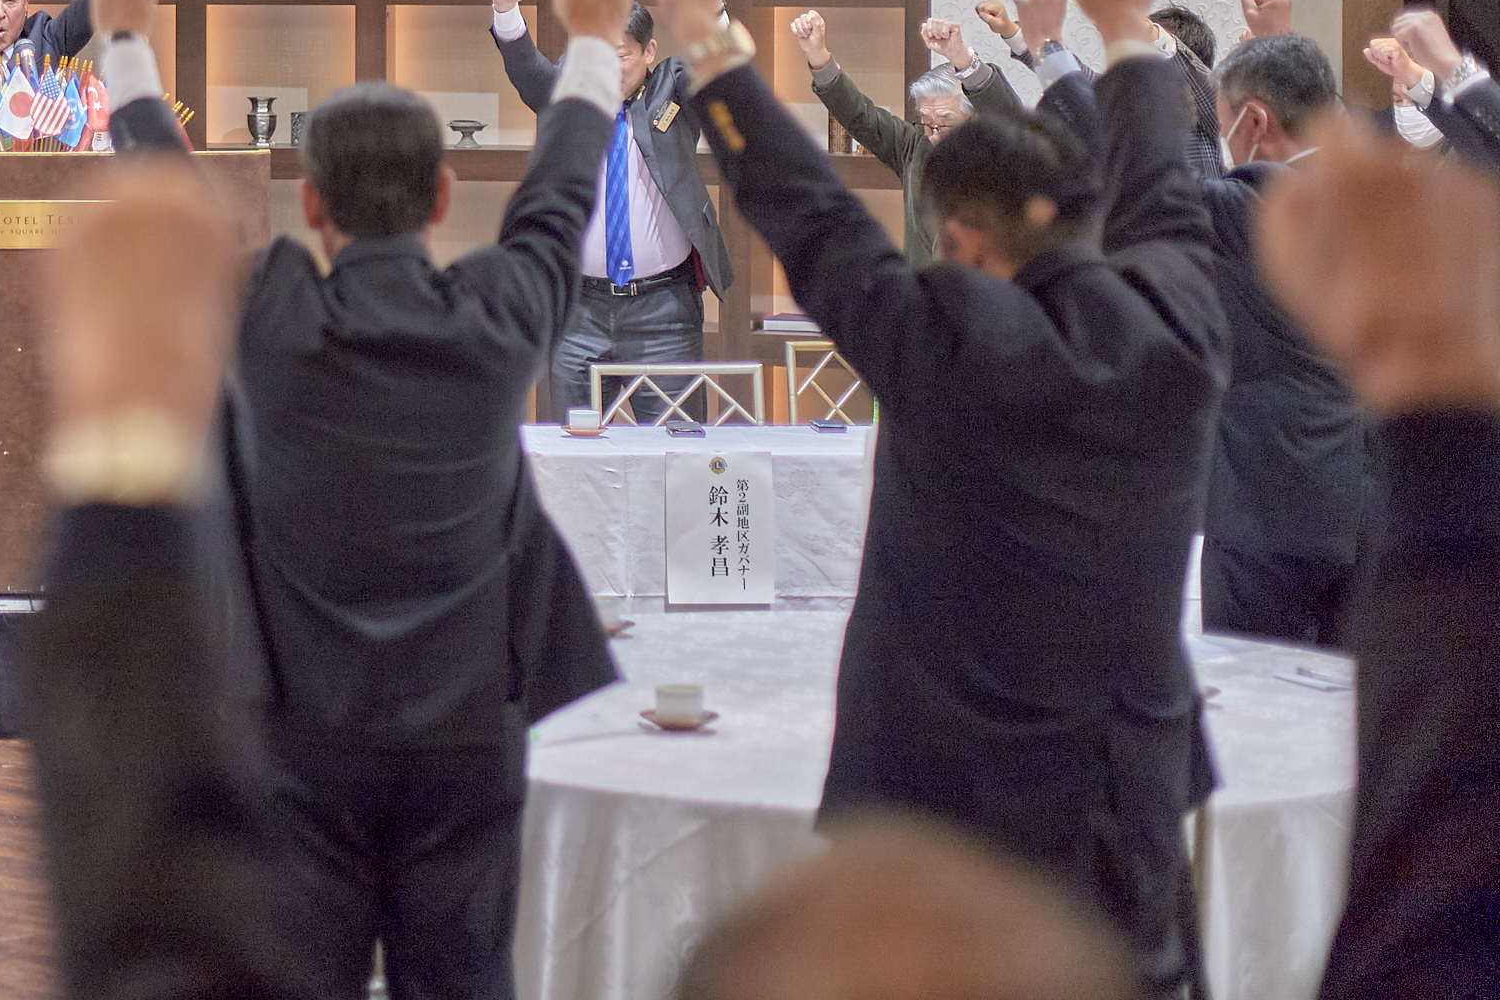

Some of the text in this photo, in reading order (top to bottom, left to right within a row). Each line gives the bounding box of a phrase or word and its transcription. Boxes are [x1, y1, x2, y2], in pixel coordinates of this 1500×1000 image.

[736, 479, 750, 590] 第2副地区ガバナー
